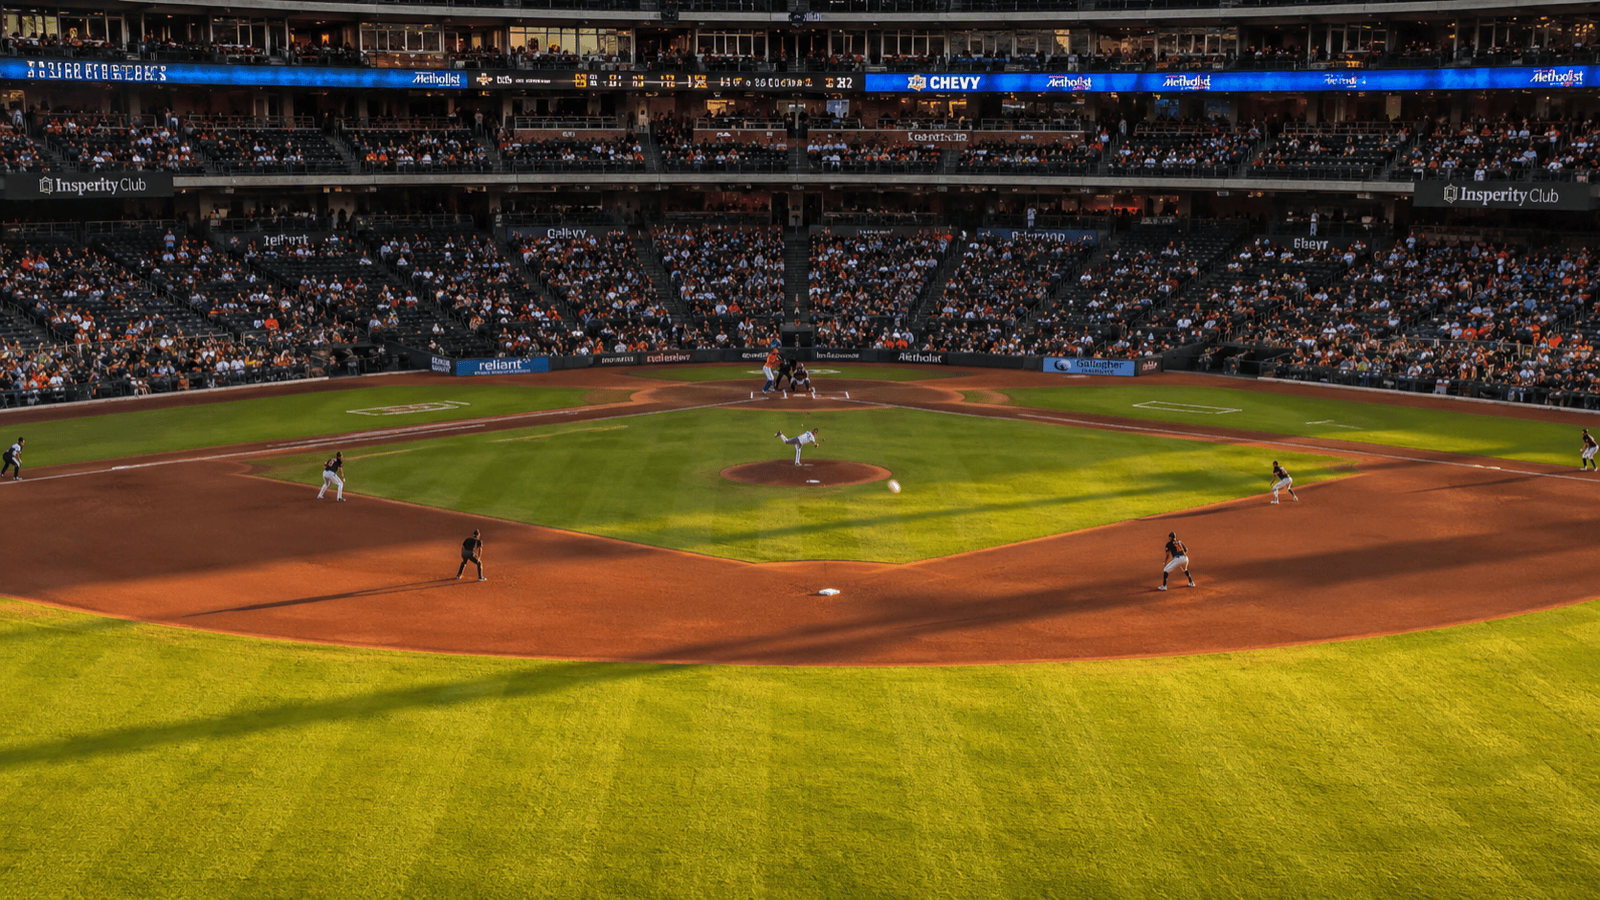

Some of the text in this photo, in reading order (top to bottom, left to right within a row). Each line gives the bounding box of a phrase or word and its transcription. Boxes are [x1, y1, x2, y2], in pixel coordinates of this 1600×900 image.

[930, 76, 981, 90] CHEVY
[55, 177, 147, 196] Insperity Club
[1460, 186, 1559, 207] Insperity Club
[479, 359, 523, 371] reliant
